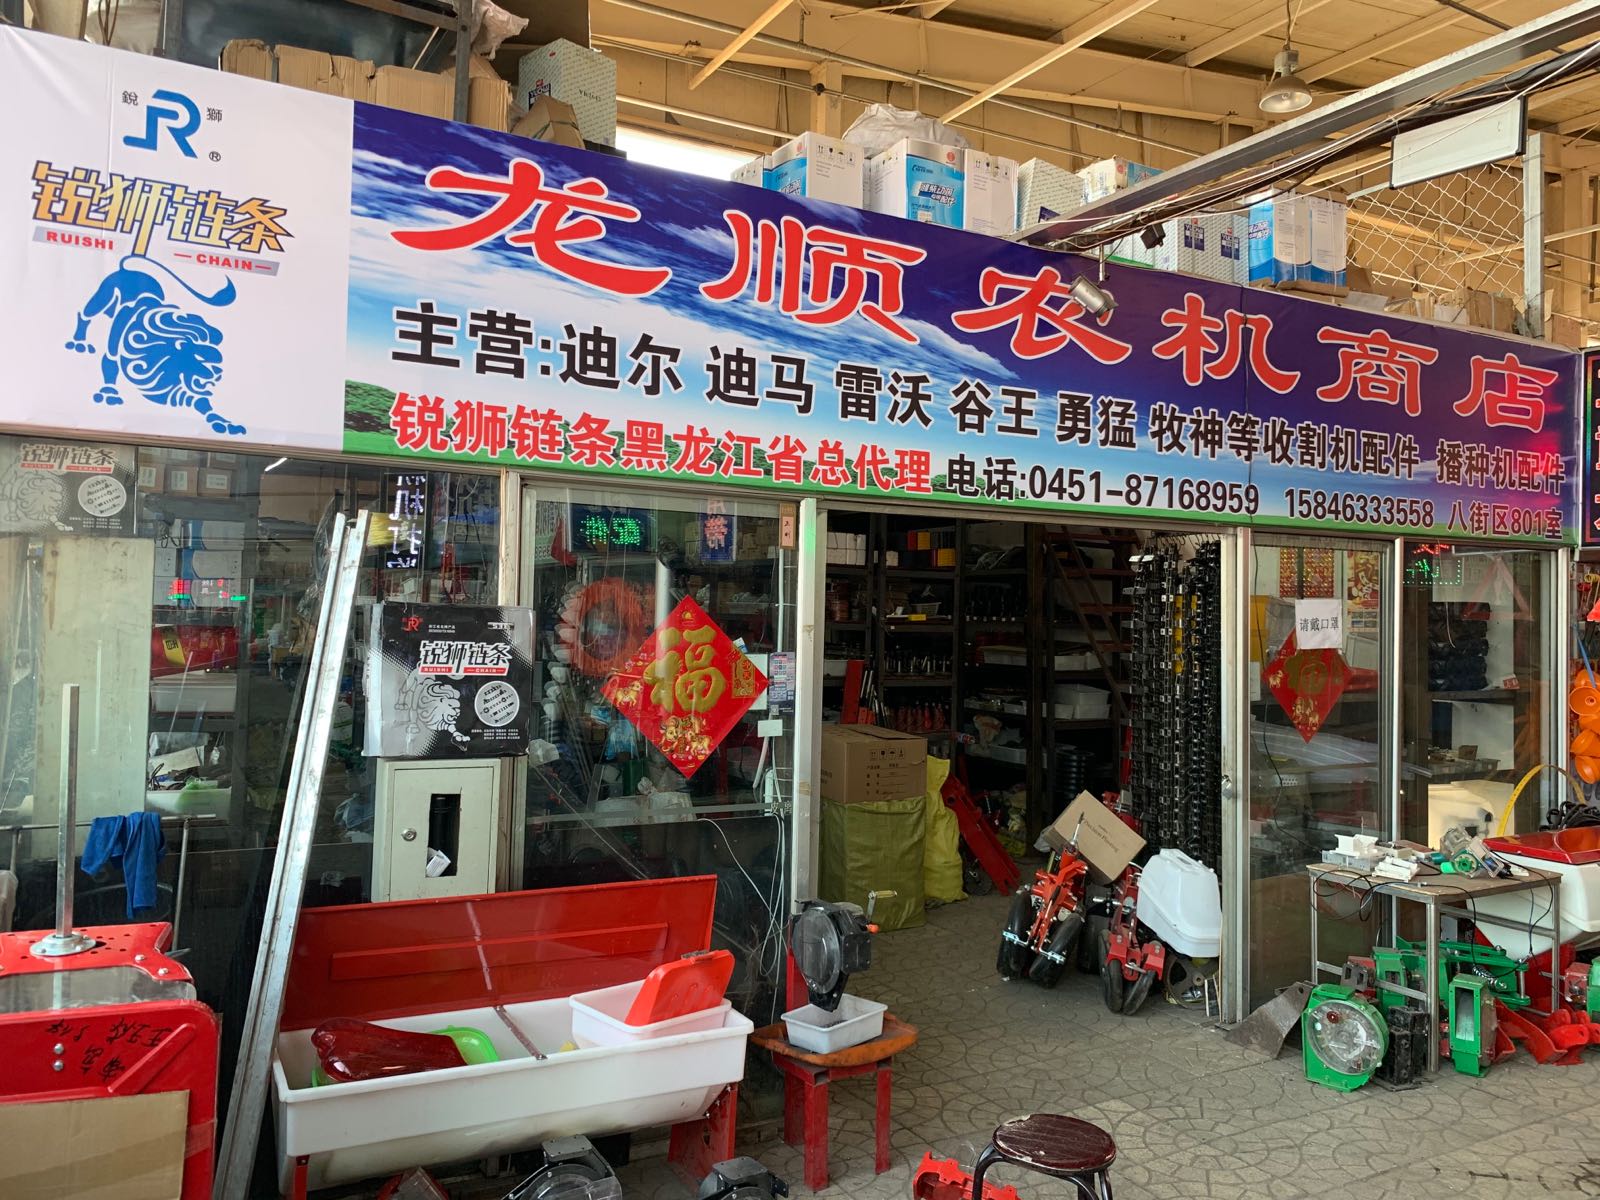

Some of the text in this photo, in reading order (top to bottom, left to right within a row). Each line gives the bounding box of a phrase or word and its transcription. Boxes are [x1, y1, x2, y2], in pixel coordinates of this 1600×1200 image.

[121, 90, 139, 106] 銳
[206, 107, 222, 123] 獅
[31, 160, 295, 257] 锐狮链条
[46, 231, 114, 250] RUISHI
[196, 253, 253, 270] CHAIN
[390, 159, 1559, 432] 龙顺农机商店
[705, 346, 814, 414] 迪马
[836, 363, 933, 428] 雷沃
[950, 380, 1038, 437] 谷王
[1056, 393, 1136, 448] 勇猛
[1150, 402, 1420, 479] 牧神等收割机配件
[1436, 439, 1565, 494] 播种机配件
[390, 392, 932, 494] 锐狮链条黑龙江省总代理
[1285, 488, 1434, 528] 15846333558
[1447, 500, 1563, 540] 八街区801室
[1299, 616, 1340, 632] 请戴口罩
[420, 640, 512, 674] 锐狮链条
[642, 624, 728, 714] 福
